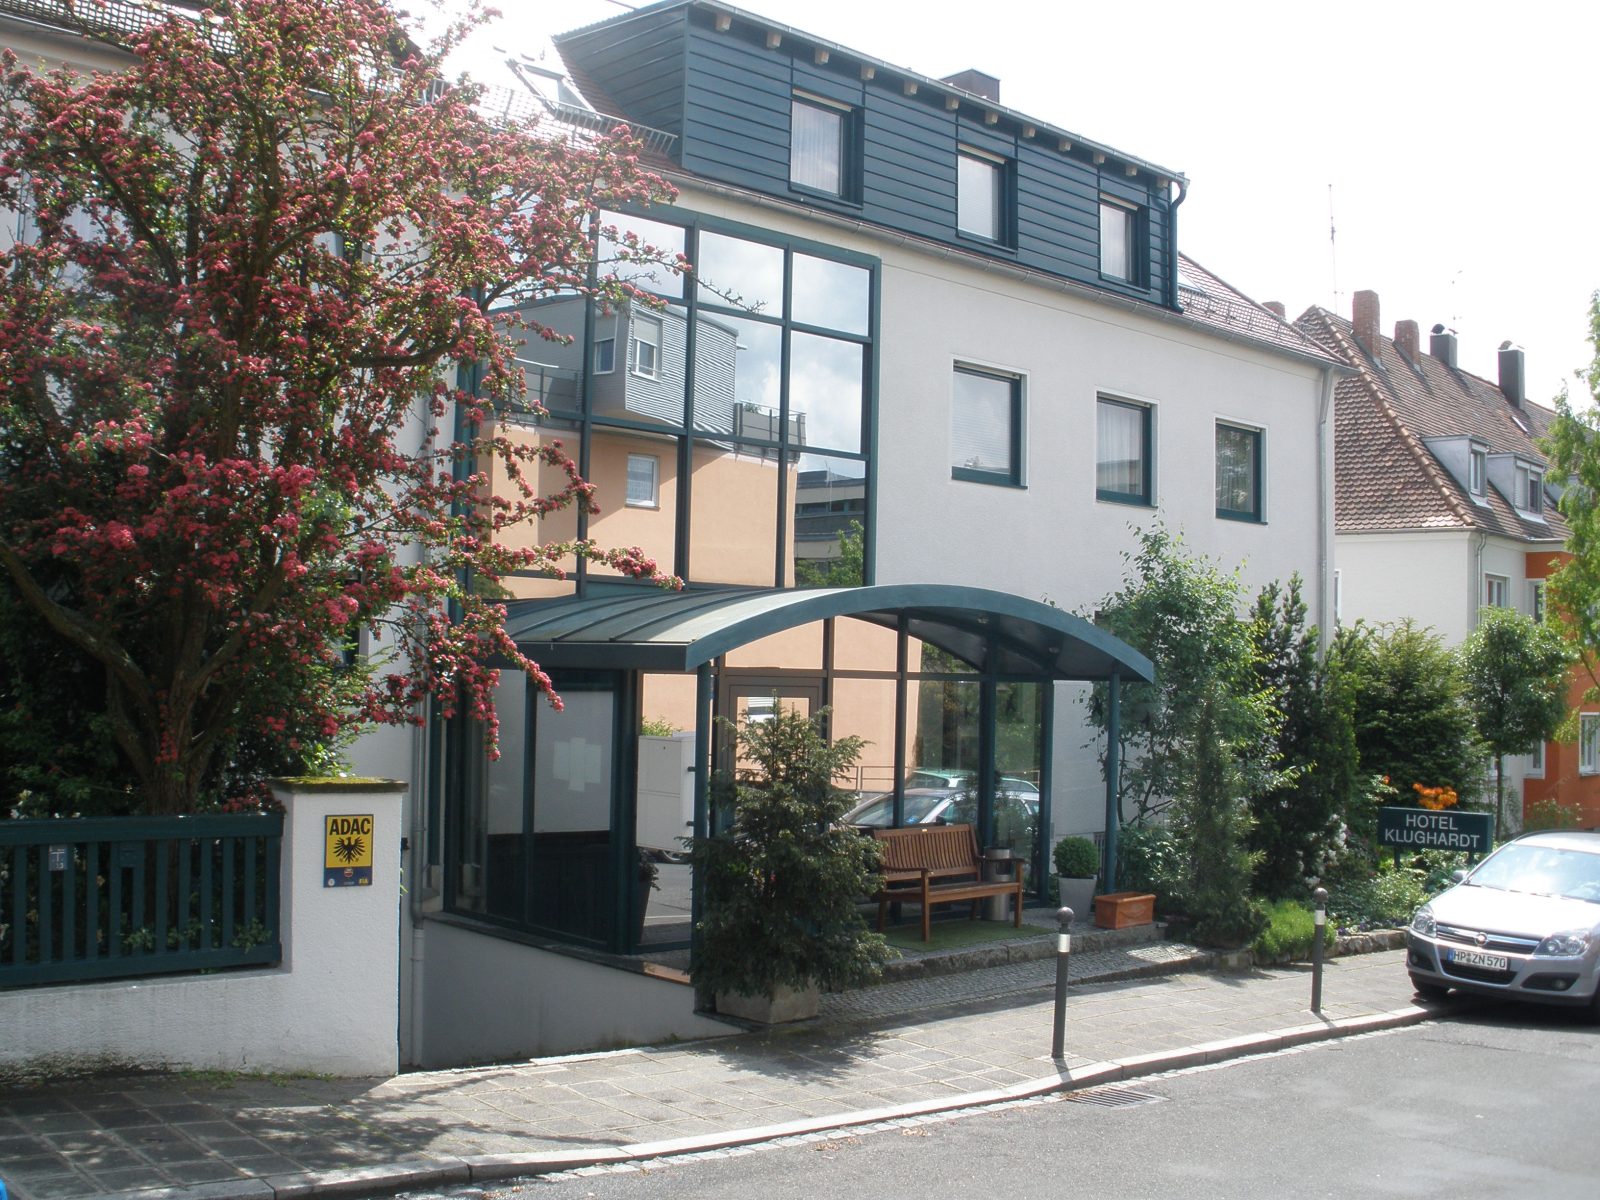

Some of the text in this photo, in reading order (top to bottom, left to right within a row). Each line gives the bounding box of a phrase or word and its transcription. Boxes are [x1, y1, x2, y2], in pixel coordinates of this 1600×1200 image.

[329, 818, 371, 836] ADAC
[1405, 813, 1458, 831] HOTEL
[1384, 828, 1480, 849] KLUGHARDT
